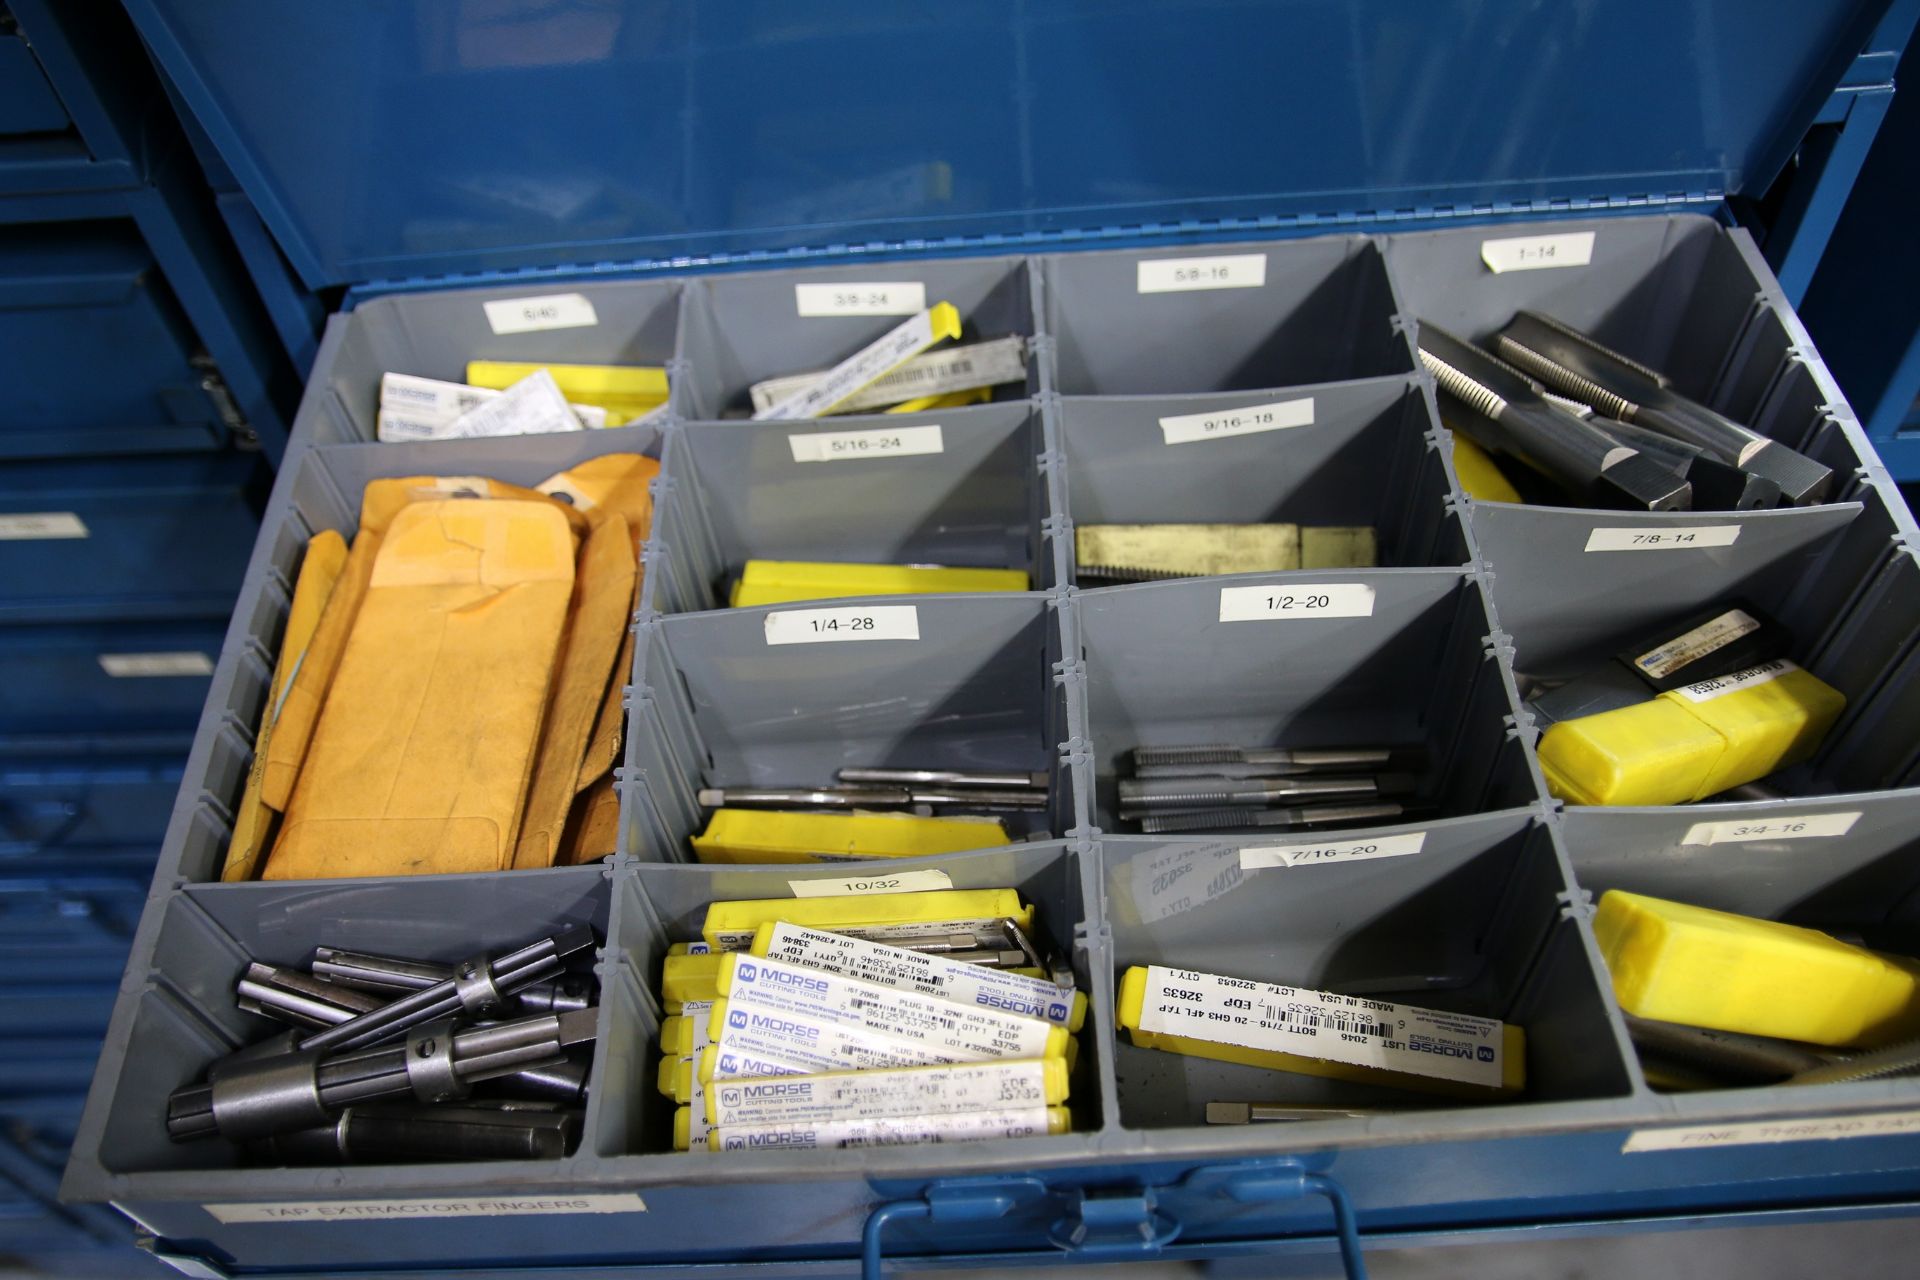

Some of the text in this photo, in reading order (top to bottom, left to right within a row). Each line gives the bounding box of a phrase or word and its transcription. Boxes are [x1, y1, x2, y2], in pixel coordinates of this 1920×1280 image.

[1520, 246, 1555, 259] 1-14
[1175, 268, 1229, 281] 5/8-16
[835, 293, 889, 306] 3/8-24
[1204, 413, 1273, 431] 9/16-18
[831, 438, 901, 452] 5/16-24
[1632, 534, 1696, 544] 7/8-14
[1266, 595, 1330, 611] 1/2-20
[810, 617, 875, 633] 1/4-28
[1688, 678, 1725, 694] 32658
[1733, 822, 1807, 837] 3/4-16
[1292, 844, 1379, 860] 7/16-20
[843, 879, 900, 892] 10/32
[782, 936, 810, 947] 33846
[800, 932, 836, 944] #326442
[839, 940, 855, 949] LOT
[767, 952, 784, 960] TAP
[783, 946, 803, 955] EDP
[819, 953, 837, 961] QTY
[837, 950, 844, 959] 6
[873, 948, 890, 957] USA
[787, 955, 801, 965] 4FL
[803, 959, 820, 968] GH3
[860, 956, 892, 969] 33846
[906, 955, 930, 965] MADE
[897, 963, 929, 977] 86125
[1178, 971, 1200, 981] QTY
[761, 968, 829, 992] MORSE
[862, 973, 896, 985] BOTTOM
[759, 981, 826, 1001] CUTTING TOOLS
[859, 990, 880, 1000] 2068
[915, 984, 950, 997] LIST 2068
[978, 985, 1046, 1005] CUTTING TOOLS
[1162, 987, 1251, 1010] EDP 32635
[1319, 993, 1394, 1012] MADE IN USA
[976, 994, 1044, 1017] MORSE
[1158, 1005, 1181, 1014] TAP
[1287, 1003, 1327, 1017] 32635
[866, 1008, 899, 1021] 86125
[904, 1016, 937, 1030] 33755
[900, 1000, 922, 1010] PLUG
[966, 1014, 985, 1024] GH3
[1005, 1022, 1022, 1031] TAP
[1185, 1008, 1204, 1017] 4FL
[1208, 1012, 1231, 1022] GH3
[1333, 1010, 1373, 1025] 86125
[752, 1015, 820, 1039] MORSE
[866, 1021, 890, 1032] MADE
[907, 1028, 925, 1039] USA
[1287, 1025, 1317, 1036] BOTT
[1398, 1020, 1406, 1029] 6
[750, 1028, 817, 1048] CUTTING TOOLS
[961, 1023, 980, 1032] QTY
[998, 1031, 1019, 1040] EDP
[945, 1038, 961, 1047] LOT
[991, 1039, 1021, 1051] 33755
[1340, 1033, 1406, 1051] LIST 2046
[1438, 1038, 1473, 1049] CUTTING
[1409, 1041, 1473, 1060] MORSE
[743, 1059, 816, 1075] MOR
[856, 1055, 890, 1068] 86125
[744, 1083, 812, 1097] MORSE
[749, 1132, 816, 1145] MORSE
[1681, 1130, 1740, 1142] FINE
[1760, 1122, 1864, 1137] THREAD
[260, 1199, 591, 1218] TAP EXTRACTOR FINGERS
